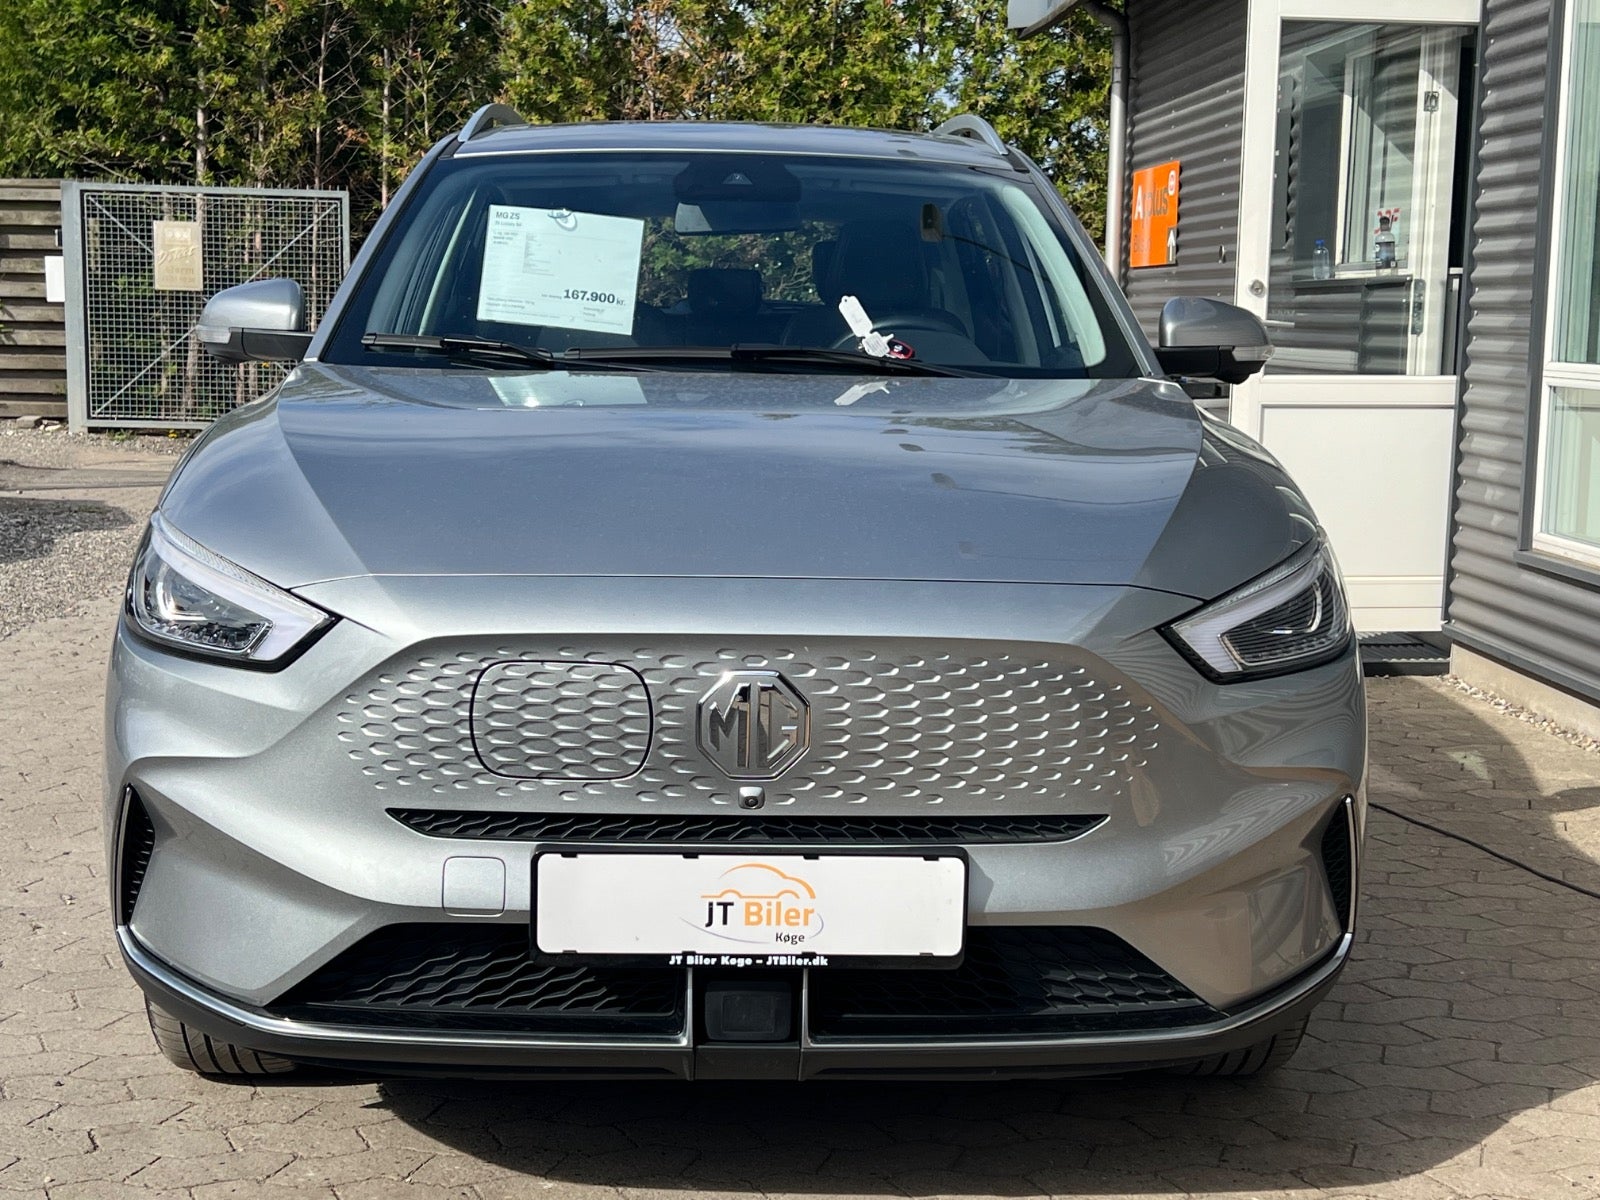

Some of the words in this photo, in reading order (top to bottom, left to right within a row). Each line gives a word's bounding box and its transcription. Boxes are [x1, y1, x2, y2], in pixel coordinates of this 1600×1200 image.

[495, 211, 509, 219] MG
[509, 212, 521, 220] ZS
[563, 289, 616, 304] 167.900
[616, 297, 627, 306] kr.
[708, 681, 798, 769] MG
[705, 901, 734, 928] JT
[745, 901, 814, 927] Biler
[775, 932, 805, 945] Køge
[668, 955, 684, 966] JT
[686, 955, 717, 966] Biler
[720, 955, 753, 968] Køge
[765, 955, 829, 967] JTBiler.dk
